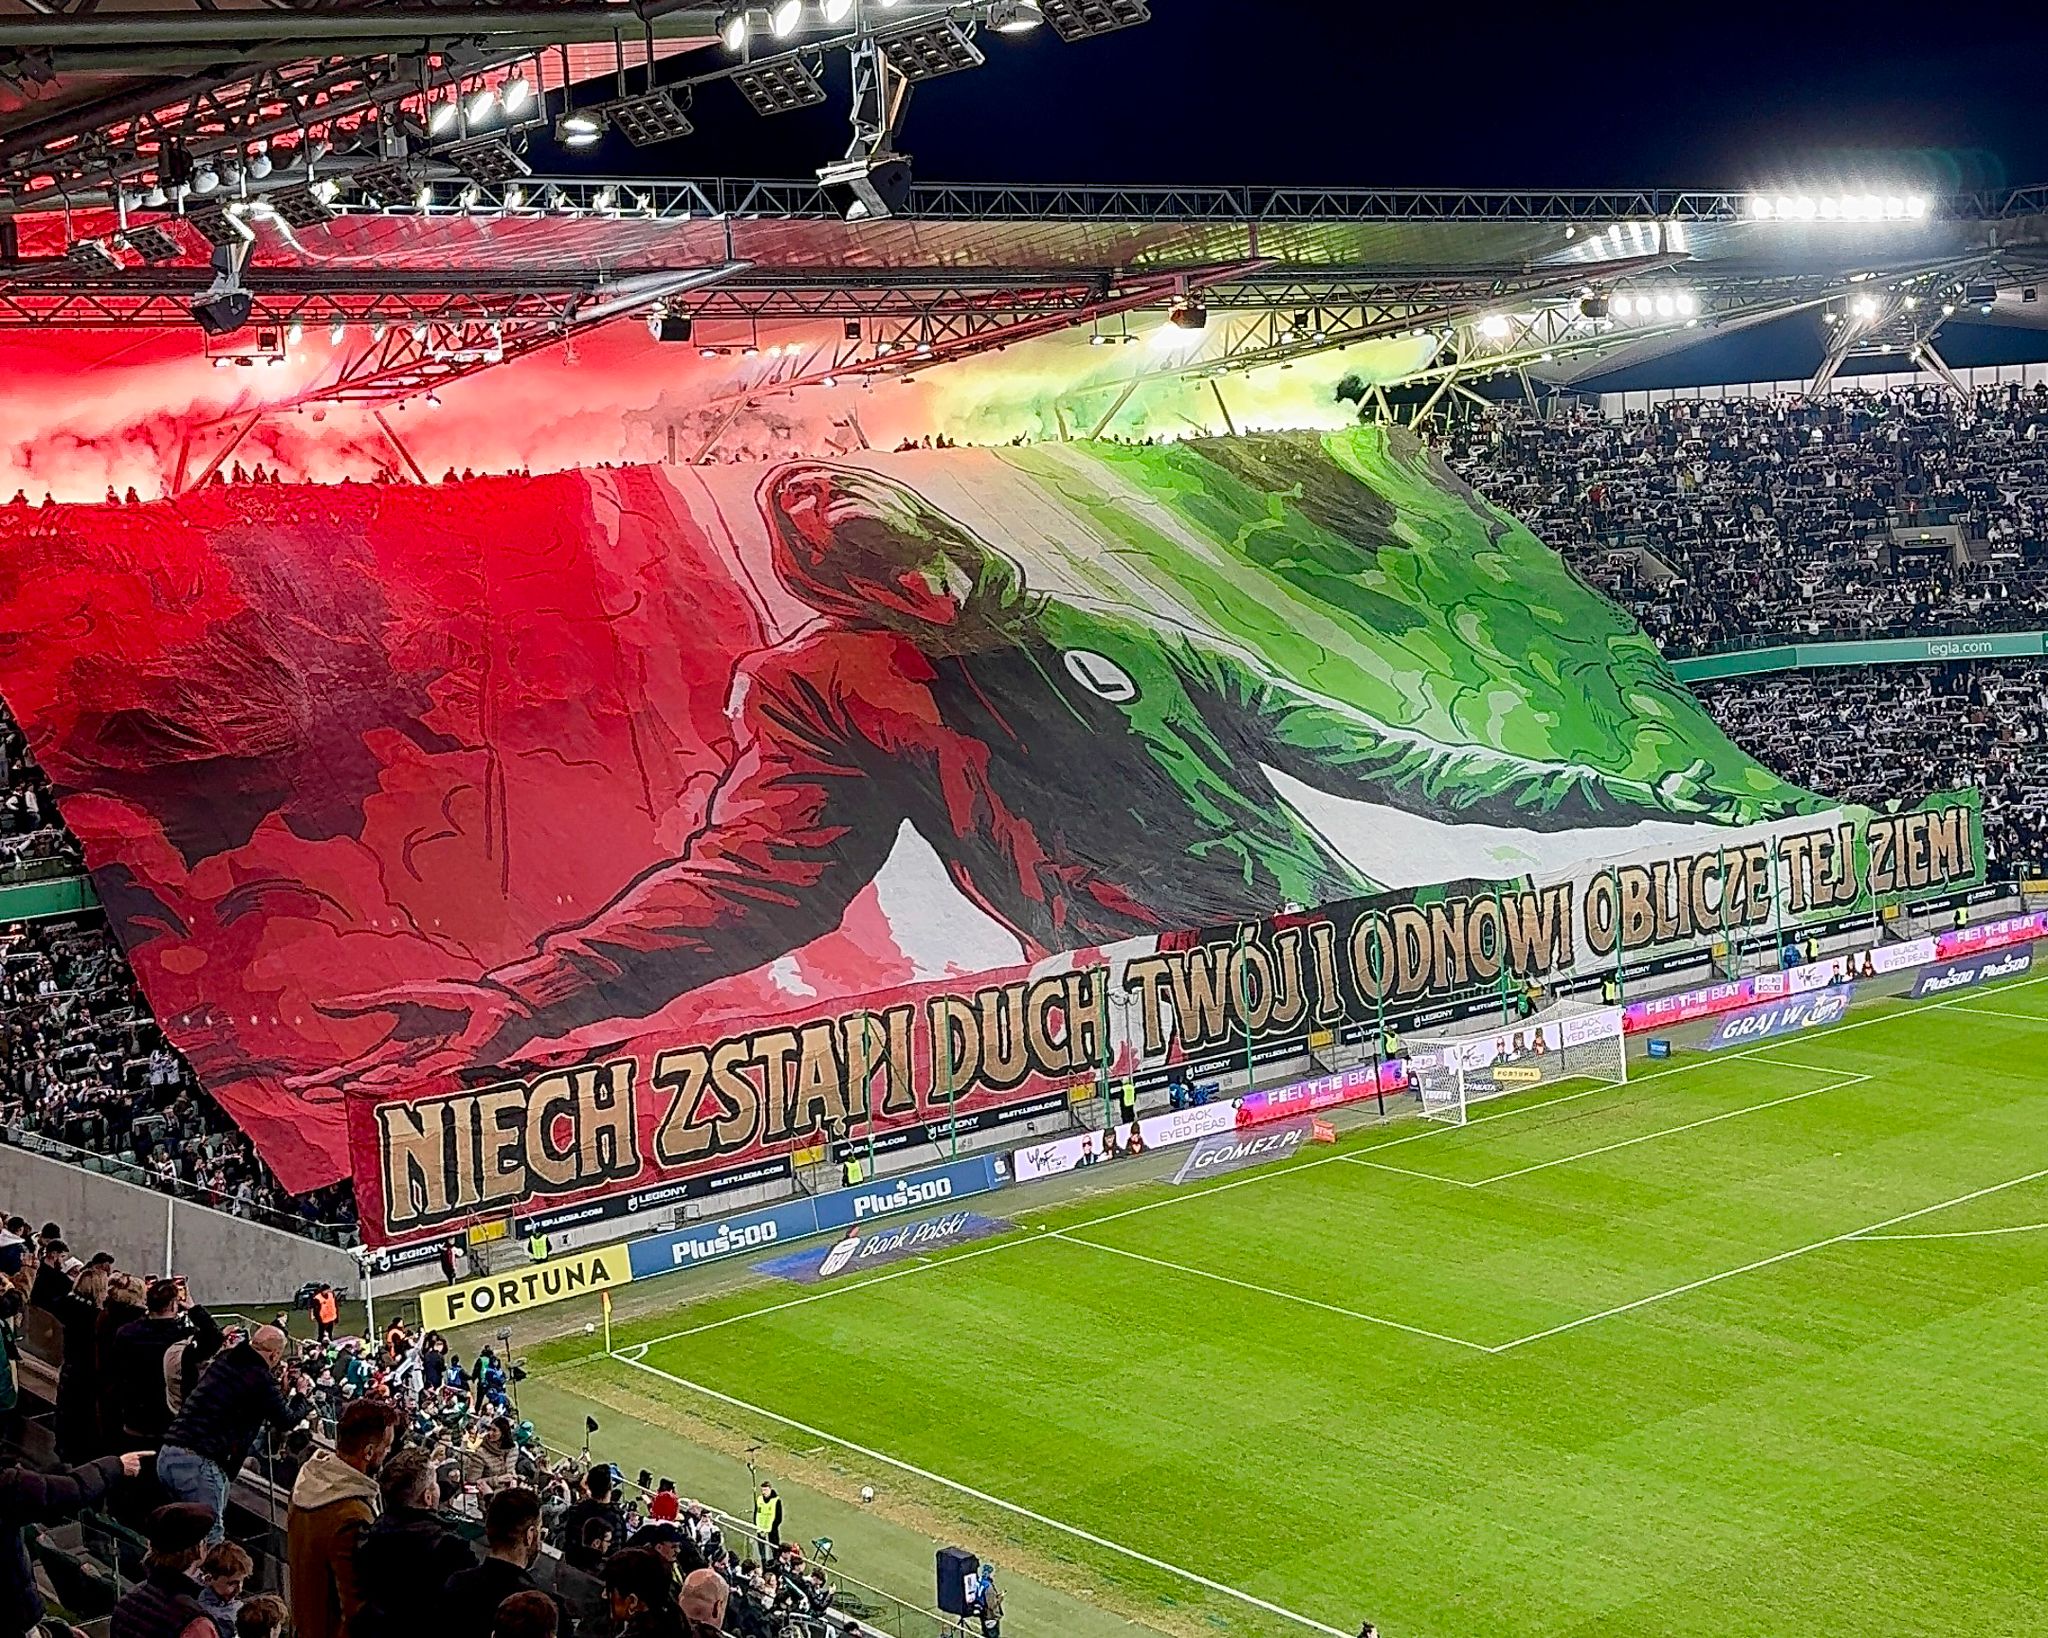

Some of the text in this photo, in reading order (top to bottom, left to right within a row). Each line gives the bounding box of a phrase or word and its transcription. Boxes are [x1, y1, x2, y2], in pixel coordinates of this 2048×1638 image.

[1921, 954, 2030, 994] Plus500 Plus500
[380, 808, 1974, 1228] NIECH ZSTĄPI DUCH TWÓJ I ODNOWI OBLICZE TEJ ZIEMI
[1723, 1010, 1779, 1039] GRAJ
[1781, 1004, 1806, 1026] W
[1307, 1075, 1343, 1095] THE
[1160, 1117, 1226, 1142] EYED PEAS
[1173, 1108, 1212, 1126] BLACK
[1194, 1129, 1303, 1168] GOMEZ.PL
[639, 1184, 688, 1204] LEGIONY
[854, 1178, 952, 1217] Plus500
[672, 1220, 778, 1264] Plus500
[860, 1212, 970, 1259] Bank Polski
[446, 1257, 611, 1321] FORTUNA
